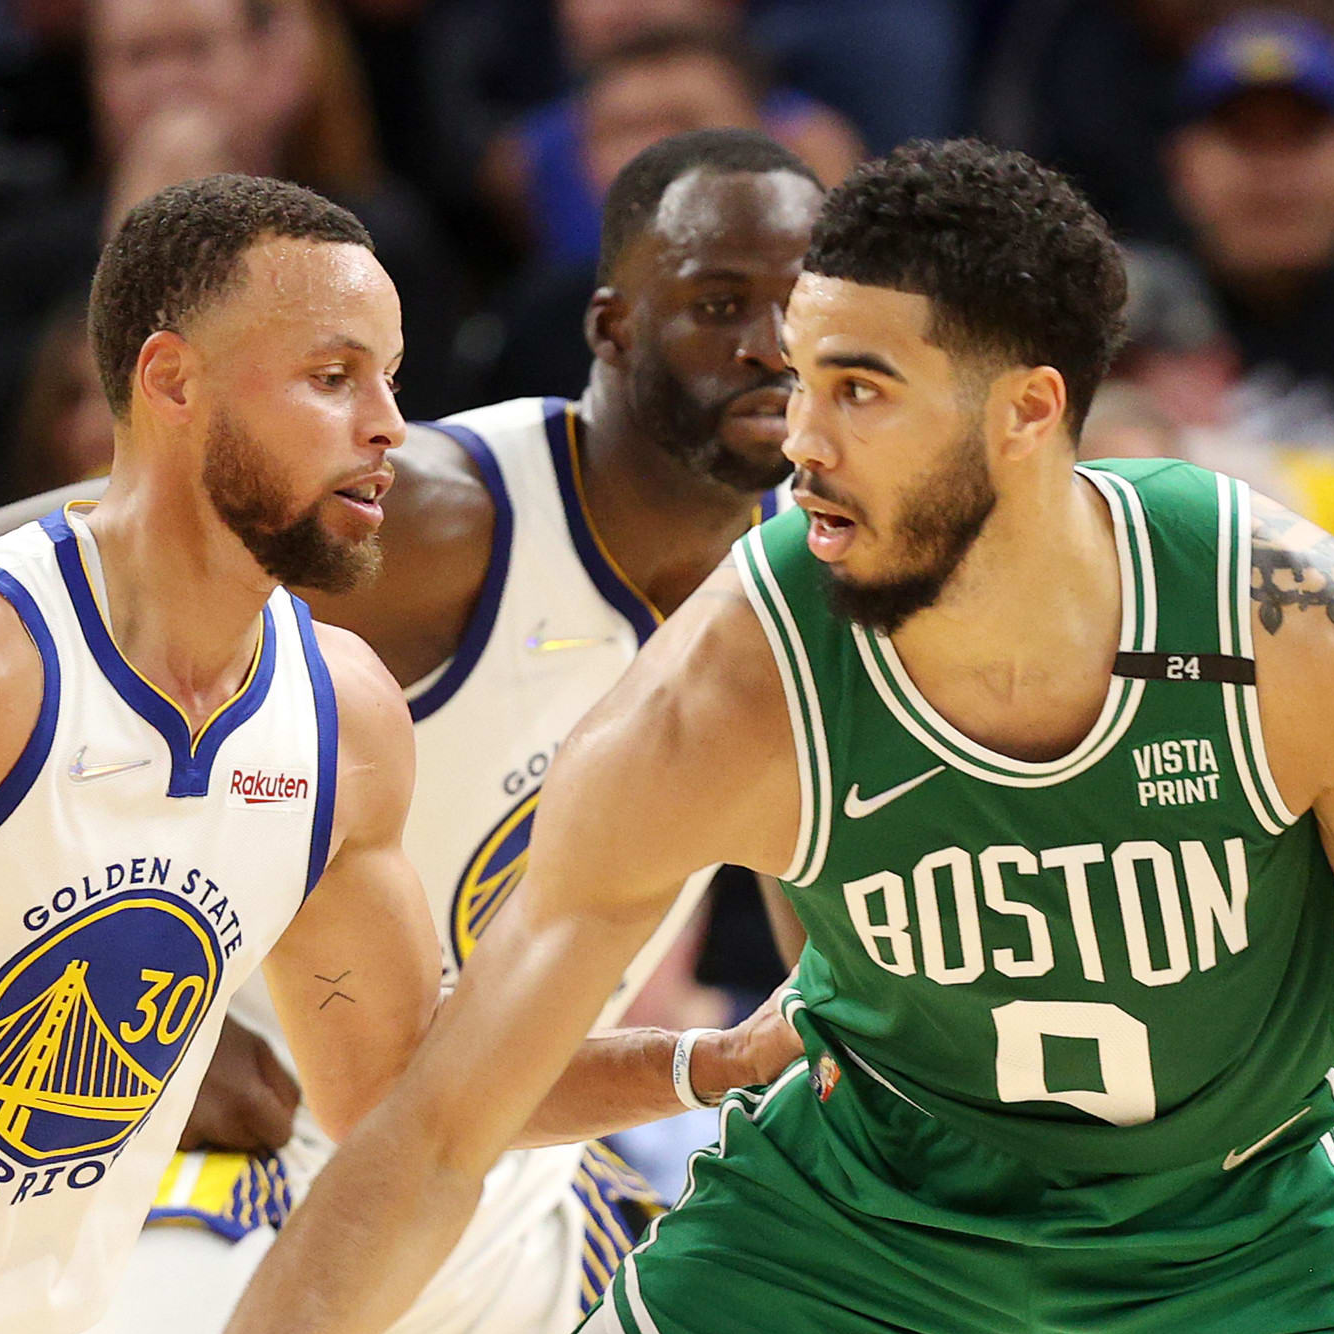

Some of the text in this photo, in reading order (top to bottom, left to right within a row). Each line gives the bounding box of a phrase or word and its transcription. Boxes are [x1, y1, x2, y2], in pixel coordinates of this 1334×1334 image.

[1167, 655, 1201, 680] 24
[230, 770, 308, 800] Rakuten
[1132, 738, 1220, 780] VISTA
[1137, 773, 1220, 807] PRINT
[23, 857, 243, 960] GOLDEN STATE
[843, 837, 1249, 987] BOSTON
[120, 968, 205, 1045] 30
[991, 1000, 1157, 1127] 0
